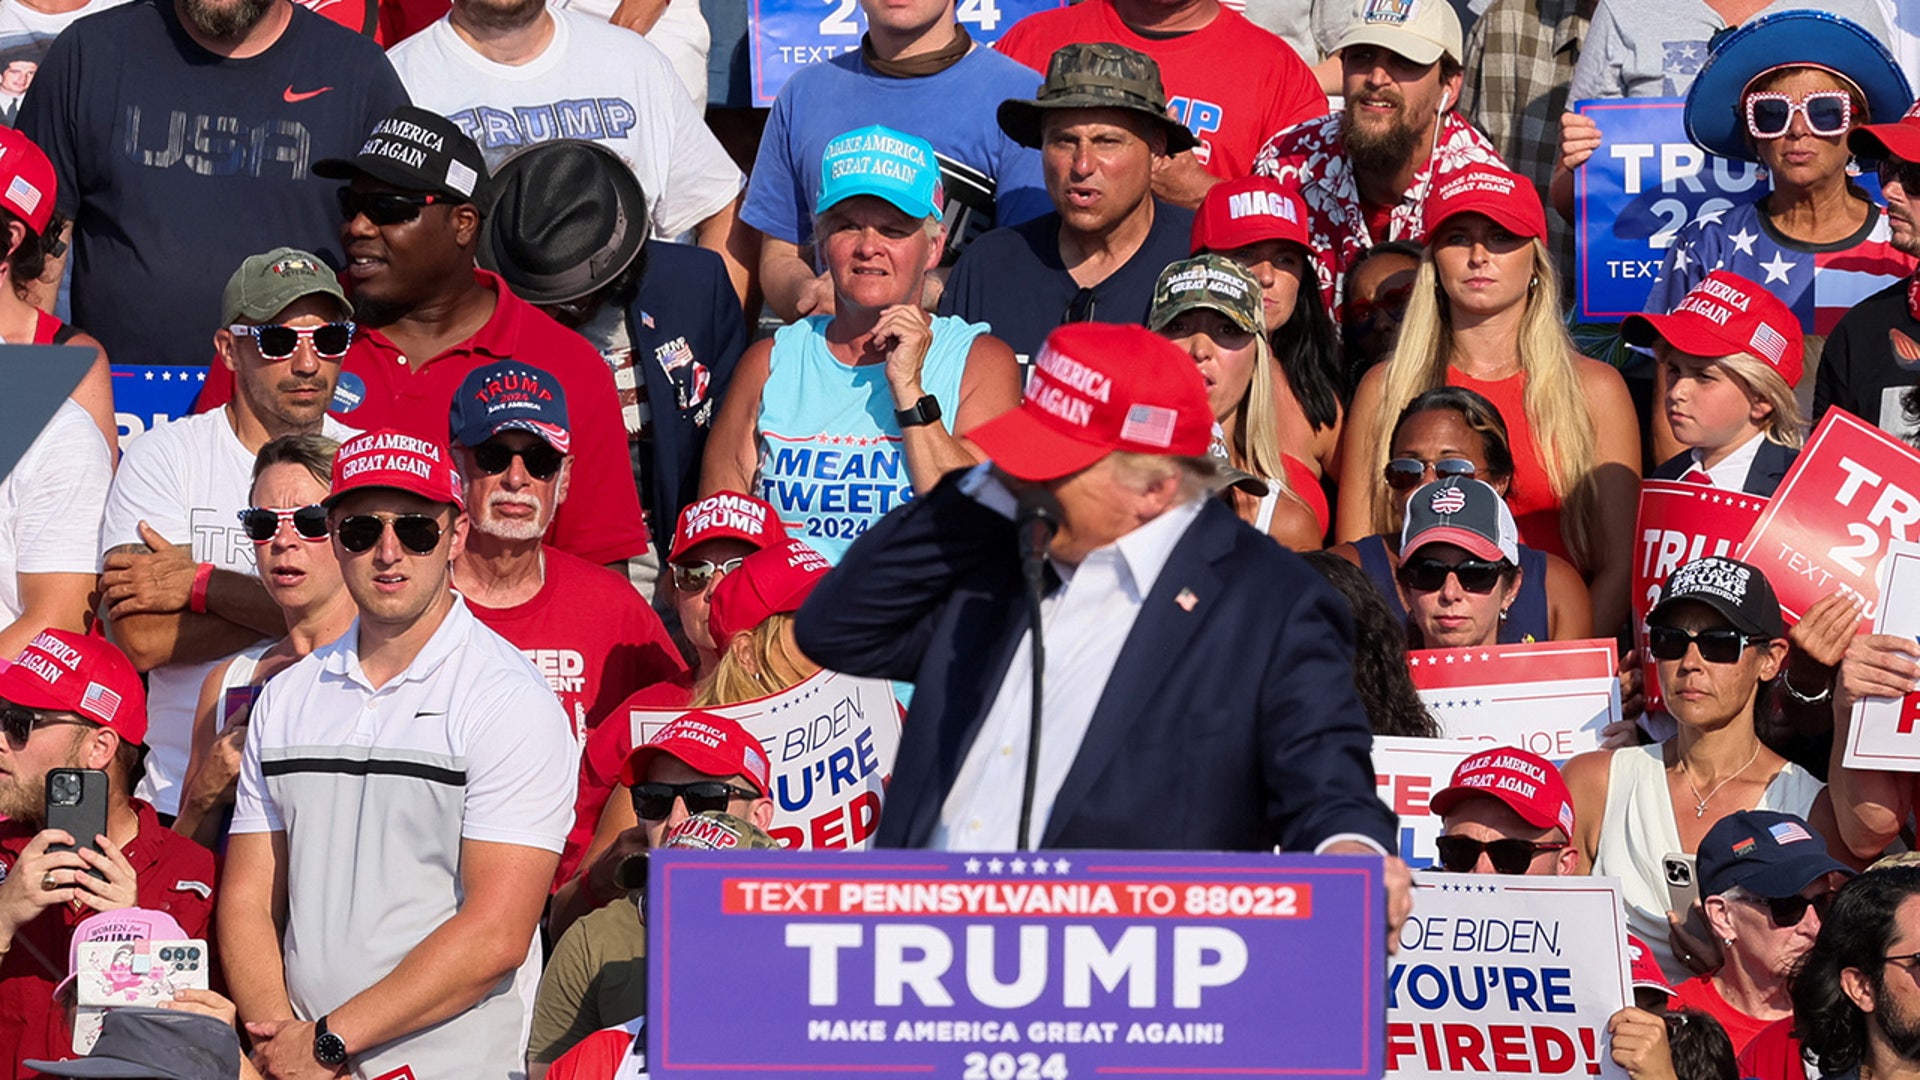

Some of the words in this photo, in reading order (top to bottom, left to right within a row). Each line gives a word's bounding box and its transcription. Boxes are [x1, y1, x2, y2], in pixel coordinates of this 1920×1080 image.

[124, 105, 312, 180] USA
[379, 119, 444, 153] AMERICA
[377, 141, 427, 169] AGAIN
[826, 136, 862, 160] MAKE
[862, 134, 926, 167] AMERICA
[831, 157, 871, 180] GREAT
[871, 158, 917, 184] AGAIN
[1610, 143, 1775, 194] TRU
[1440, 176, 1465, 195] MAKE
[1467, 172, 1515, 188] AMERICA
[1442, 182, 1475, 200] GREAT
[1477, 182, 1511, 195] AGAIN
[1229, 191, 1298, 225] MAGA
[1167, 268, 1200, 287] MAKE
[1200, 268, 1248, 292] AMERICA
[1170, 280, 1206, 294] GREAT
[1208, 281, 1241, 299] AGAIN
[1689, 300, 1732, 326] AGAIN
[475, 374, 553, 403] TRUMP
[500, 391, 529, 403] 2024
[1037, 386, 1094, 427] AGAIN
[338, 434, 374, 463] MAKE
[374, 433, 440, 462] AMERICA
[342, 456, 386, 480] GREAT
[386, 454, 432, 480] AGAIN
[774, 447, 900, 481] MEAN
[685, 495, 766, 522] WOMEN
[685, 509, 763, 539] TRUMP
[807, 517, 869, 540] 2024
[1676, 558, 1751, 580] JESUS
[1777, 542, 1833, 587] TEXT
[1671, 574, 1746, 597] TRUMP
[22, 653, 64, 684] AGAIN
[672, 720, 728, 742] AMERICA
[678, 729, 720, 749] AGAIN
[1459, 756, 1491, 777] MAKE
[1491, 756, 1547, 785] AMERICA
[1495, 777, 1537, 799] AGAIN
[737, 882, 831, 911] TEXT
[839, 884, 1119, 914] PENNSYLVANIA
[1126, 885, 1176, 914] TO
[1184, 886, 1298, 916] 88022
[92, 924, 127, 937] WOMEN
[1452, 918, 1561, 957] BIDEN,
[785, 923, 1249, 1009] TRUMP
[808, 1020, 887, 1041] MAKE
[894, 1021, 1020, 1042] AMERICA
[1027, 1021, 1119, 1043] GREAT
[1125, 1022, 1224, 1044] AGAIN!
[1386, 1022, 1603, 1076] FIRED!
[963, 1051, 1068, 1080] 2024
